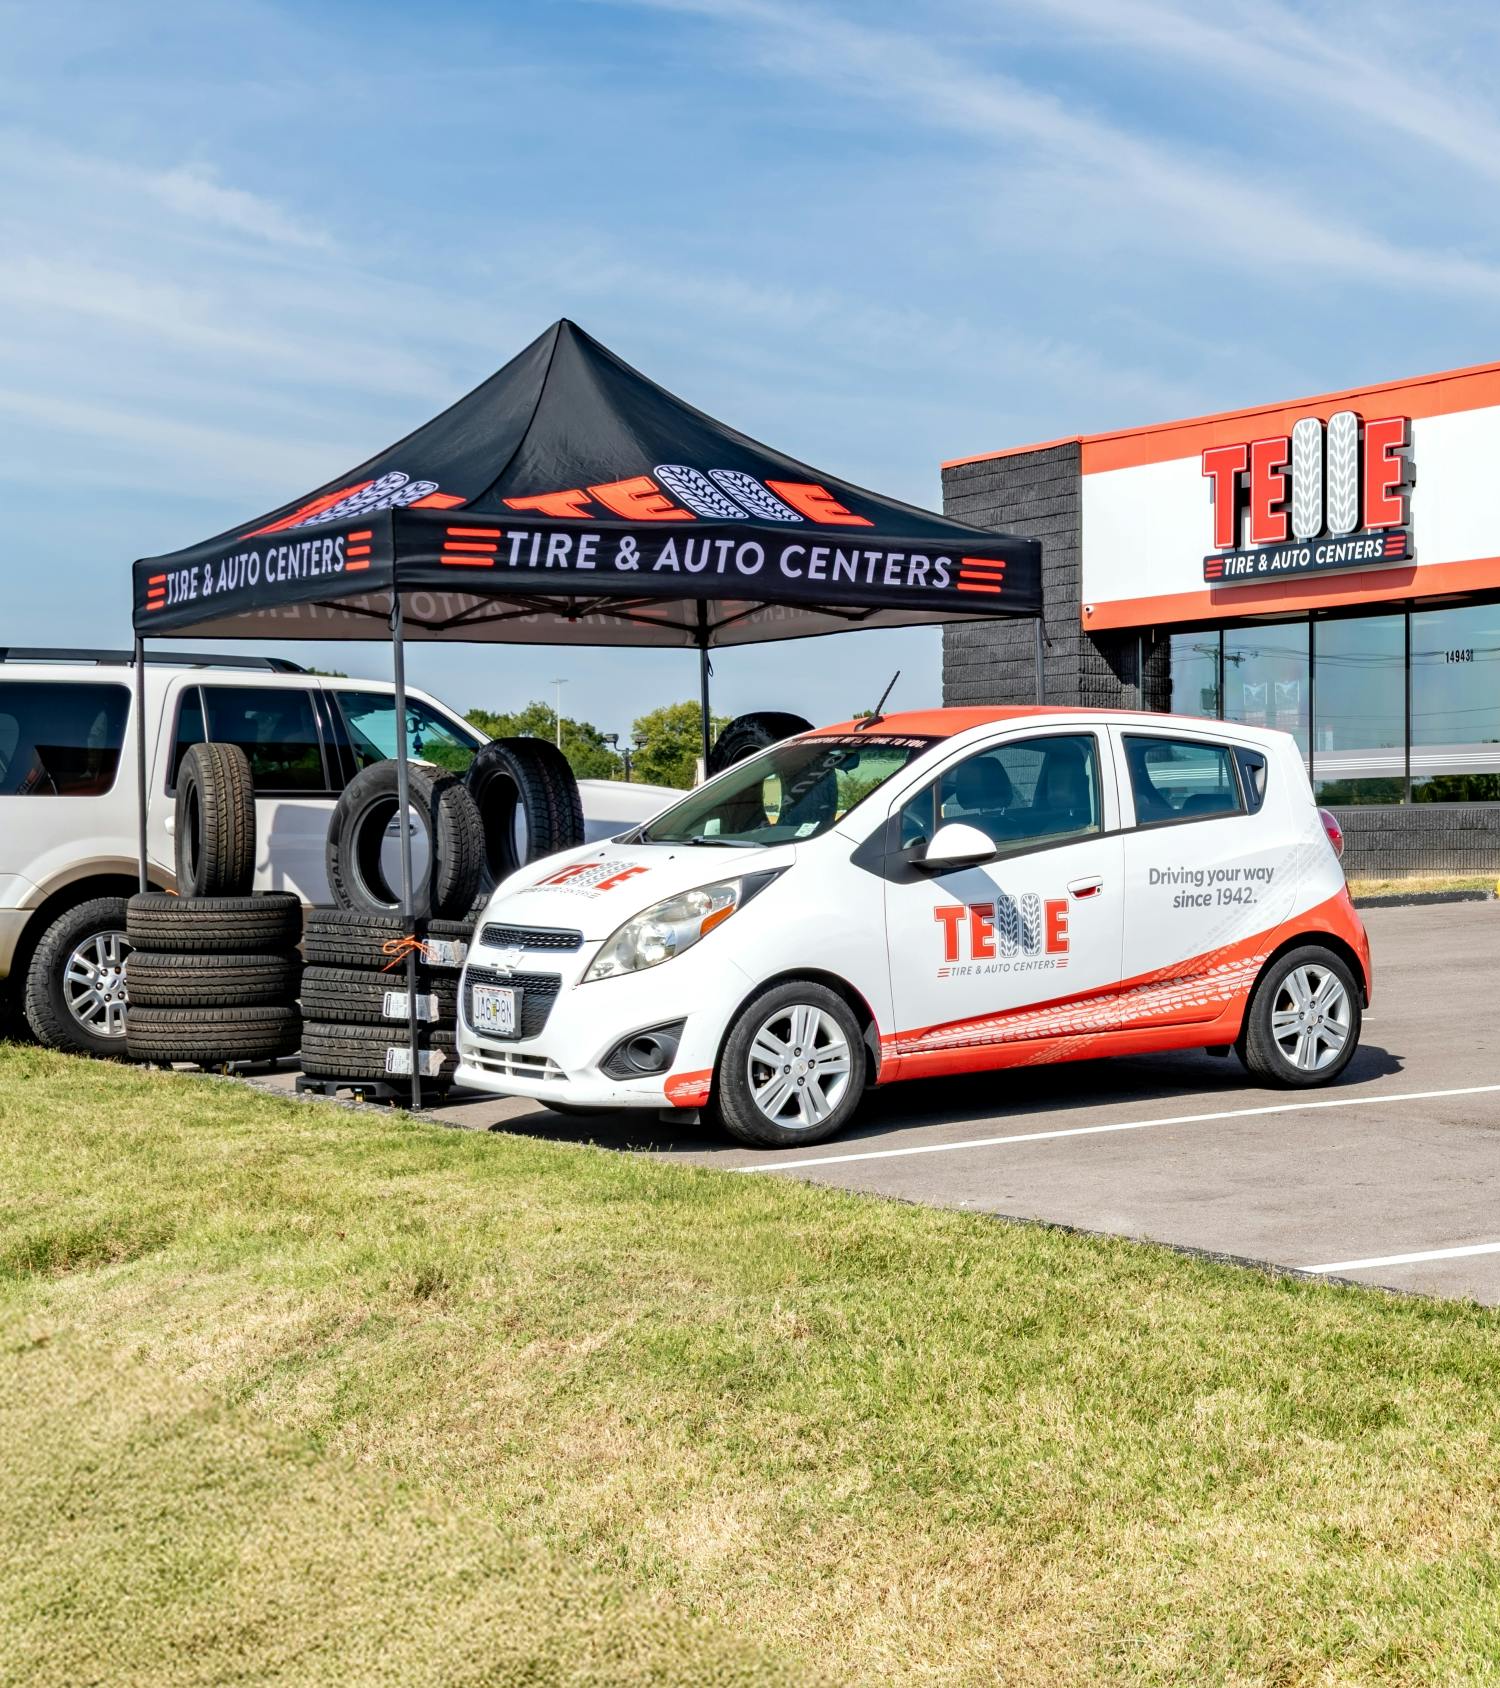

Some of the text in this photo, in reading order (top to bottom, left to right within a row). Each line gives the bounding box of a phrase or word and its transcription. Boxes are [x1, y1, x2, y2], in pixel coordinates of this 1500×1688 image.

[165, 536, 346, 605] TIRE & AUTO CENTERS
[506, 531, 953, 590] TIRE & AUTO CENTERS
[1224, 538, 1384, 576] TIRE & AUTO CENTERS
[331, 853, 360, 911] NERAL
[1149, 866, 1275, 890] Driving your way
[1173, 887, 1257, 908] since 1942.
[950, 959, 1056, 977] TIRE & AUTO CENTERS
